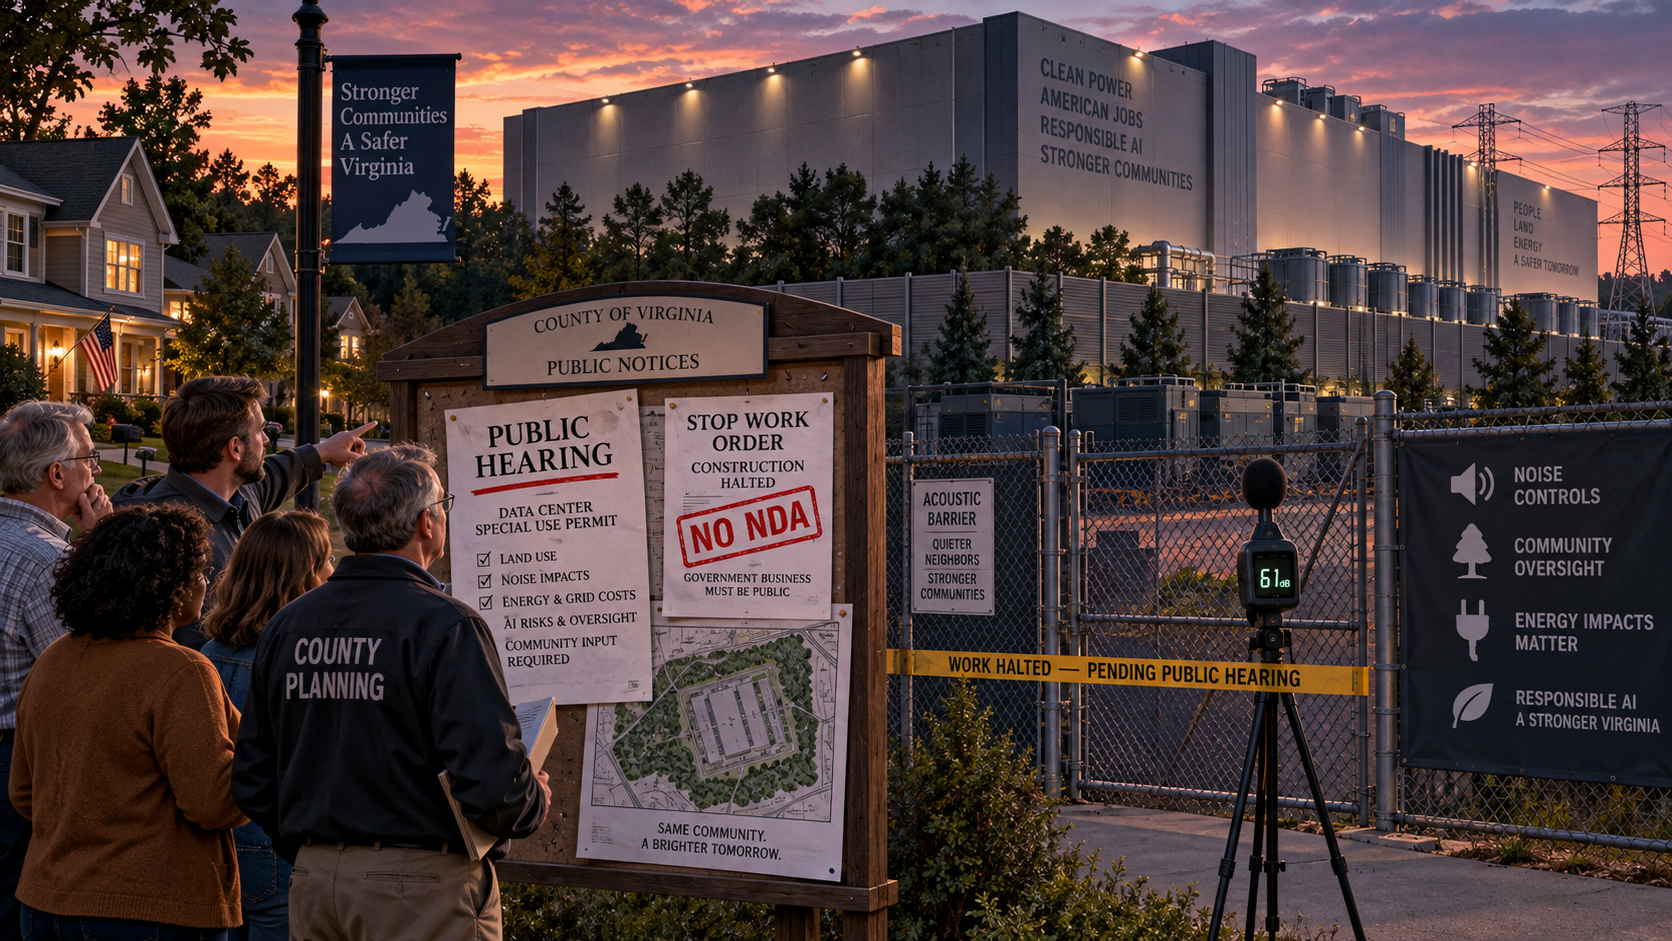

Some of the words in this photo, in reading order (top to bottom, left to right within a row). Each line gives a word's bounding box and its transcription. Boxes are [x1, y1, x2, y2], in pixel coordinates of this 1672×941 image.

[1041, 58, 1083, 86] CLEAN
[1089, 71, 1132, 100] POWER
[342, 83, 418, 105] Stronger
[341, 106, 447, 125] Communities
[1041, 87, 1108, 121] AMERICAN
[1113, 106, 1143, 128] JOBS
[340, 132, 355, 150] A
[361, 130, 408, 150] Safer
[1041, 115, 1127, 152] RESPONSIBLE
[1131, 137, 1142, 155] AI
[340, 157, 414, 180] Virginia
[1041, 144, 1110, 175] STRONGER
[1114, 160, 1192, 191] COMMUNITIES
[1514, 201, 1541, 220] PEOPLE
[1514, 218, 1533, 234] LAND
[1514, 236, 1542, 253] ENERGY
[1514, 254, 1519, 266] A
[1521, 255, 1542, 269] SAFER
[1543, 260, 1579, 276] TOMORROW
[534, 310, 604, 333] COUNTY
[610, 307, 631, 321] OF
[637, 306, 713, 324] VIRGINIA
[548, 358, 611, 375] PUBLIC
[618, 354, 699, 372] NOTICES
[687, 414, 738, 430] STOP
[744, 411, 809, 428] WORK
[488, 416, 589, 448] PUBLIC
[713, 434, 784, 451] ORDER
[476, 442, 613, 479] HEARING
[692, 460, 804, 474] CONSTRUCTION
[721, 477, 775, 488] HALTED
[1515, 466, 1562, 482] NOISE
[923, 492, 981, 506] ACOUSTIC
[1515, 488, 1600, 505] CONTROLS
[499, 506, 534, 518] DATA
[538, 502, 593, 516] CENTER
[476, 521, 532, 536] SPECIAL
[536, 519, 561, 532] USE
[566, 515, 617, 529] PERMIT
[690, 518, 735, 554] NO
[744, 500, 810, 541] NDA
[928, 512, 976, 526] BARRIER
[933, 538, 972, 550] QUIETER
[1515, 538, 1612, 553] COMMUNITY
[500, 553, 532, 564] LAND
[536, 551, 557, 562] USE
[926, 554, 980, 566] NEIGHBORS
[1515, 560, 1604, 576] OVERSIGHT
[502, 574, 536, 585] NOISE
[540, 570, 589, 583] IMPACTS
[684, 573, 758, 582] GOVERNMENT
[762, 574, 811, 583] BUSINESS
[928, 573, 976, 584] STRONGER
[502, 595, 550, 607] ENERGY
[554, 594, 562, 604] &
[566, 592, 594, 604] GRID
[598, 590, 636, 602] COSTS
[705, 586, 734, 596] MUST
[737, 587, 749, 596] BE
[753, 587, 790, 597] PUBLIC
[921, 588, 985, 600] COMMUNITIES
[504, 616, 516, 629] AI
[521, 616, 553, 628] RISKS
[557, 616, 566, 626] &
[570, 612, 637, 626] OVERSIGHT
[1516, 612, 1578, 628] ENERGY
[1584, 614, 1654, 630] IMPACTS
[295, 638, 382, 665] COUNTY
[506, 638, 578, 651] COMMUNITY
[582, 635, 617, 647] INPUT
[1516, 635, 1578, 652] MATTER
[507, 654, 570, 668] REQUIRED
[948, 656, 991, 674] WORK
[997, 658, 1051, 676] HALTED
[1088, 662, 1156, 681] PENDING
[1162, 665, 1219, 684] PUBLIC
[1226, 668, 1300, 687] HEARING
[286, 672, 384, 700] PLANNING
[1516, 690, 1616, 709] RESPONSIBLE
[1622, 694, 1636, 709] AI
[1516, 712, 1524, 726] A
[1529, 713, 1597, 730] STRONGER
[1602, 716, 1660, 733] VIRGINIA
[658, 822, 689, 835] SAME
[693, 825, 766, 842] COMMUNITY.
[641, 838, 648, 849] A
[653, 839, 708, 854] BRIGHTER
[712, 843, 781, 860] TOMORROW.
